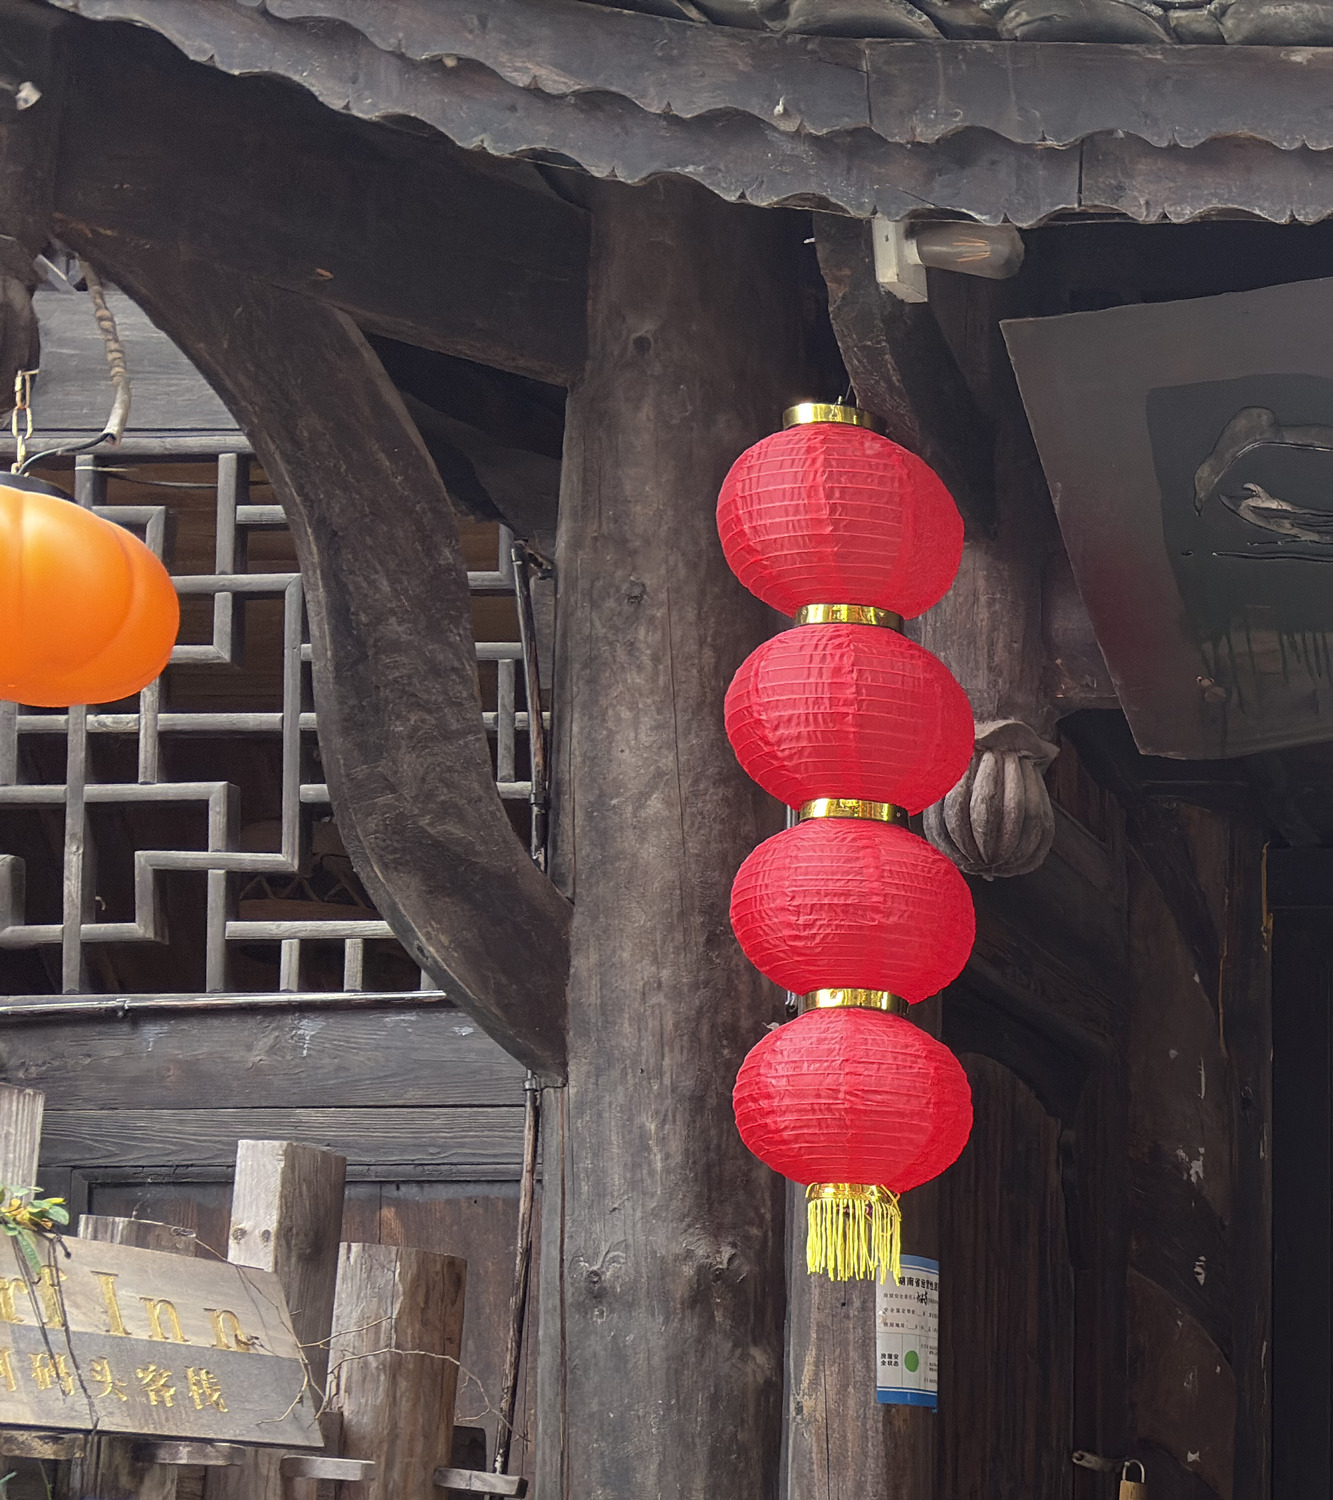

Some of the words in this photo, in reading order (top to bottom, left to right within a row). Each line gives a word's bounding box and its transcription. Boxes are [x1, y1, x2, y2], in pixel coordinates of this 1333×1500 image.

[90, 1270, 252, 1351] Inn
[0, 1350, 229, 1413] 码头客栈
